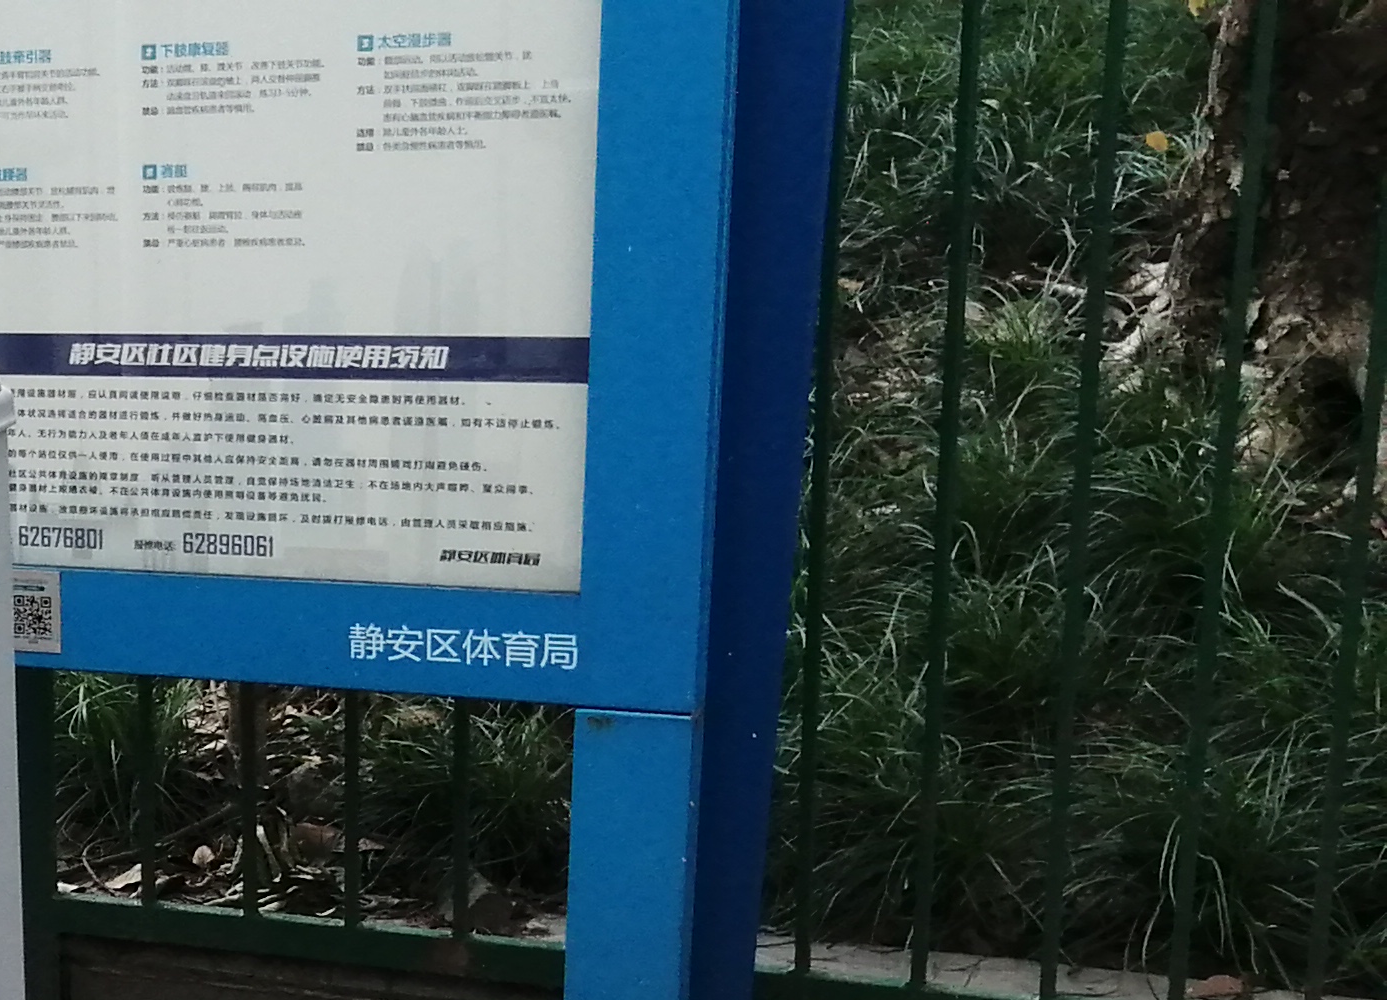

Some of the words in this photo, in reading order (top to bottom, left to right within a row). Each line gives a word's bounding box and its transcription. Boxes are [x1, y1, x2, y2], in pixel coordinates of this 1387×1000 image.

[161, 41, 229, 58] 下肢康复器
[378, 32, 452, 48] 太空漫步器
[69, 343, 449, 370] 静安区社区健身点设施使用须知
[19, 525, 104, 550] 62676801
[183, 532, 274, 557] 62896061
[439, 549, 541, 566] 静安区体育局
[348, 622, 577, 671] 静安区体育局
